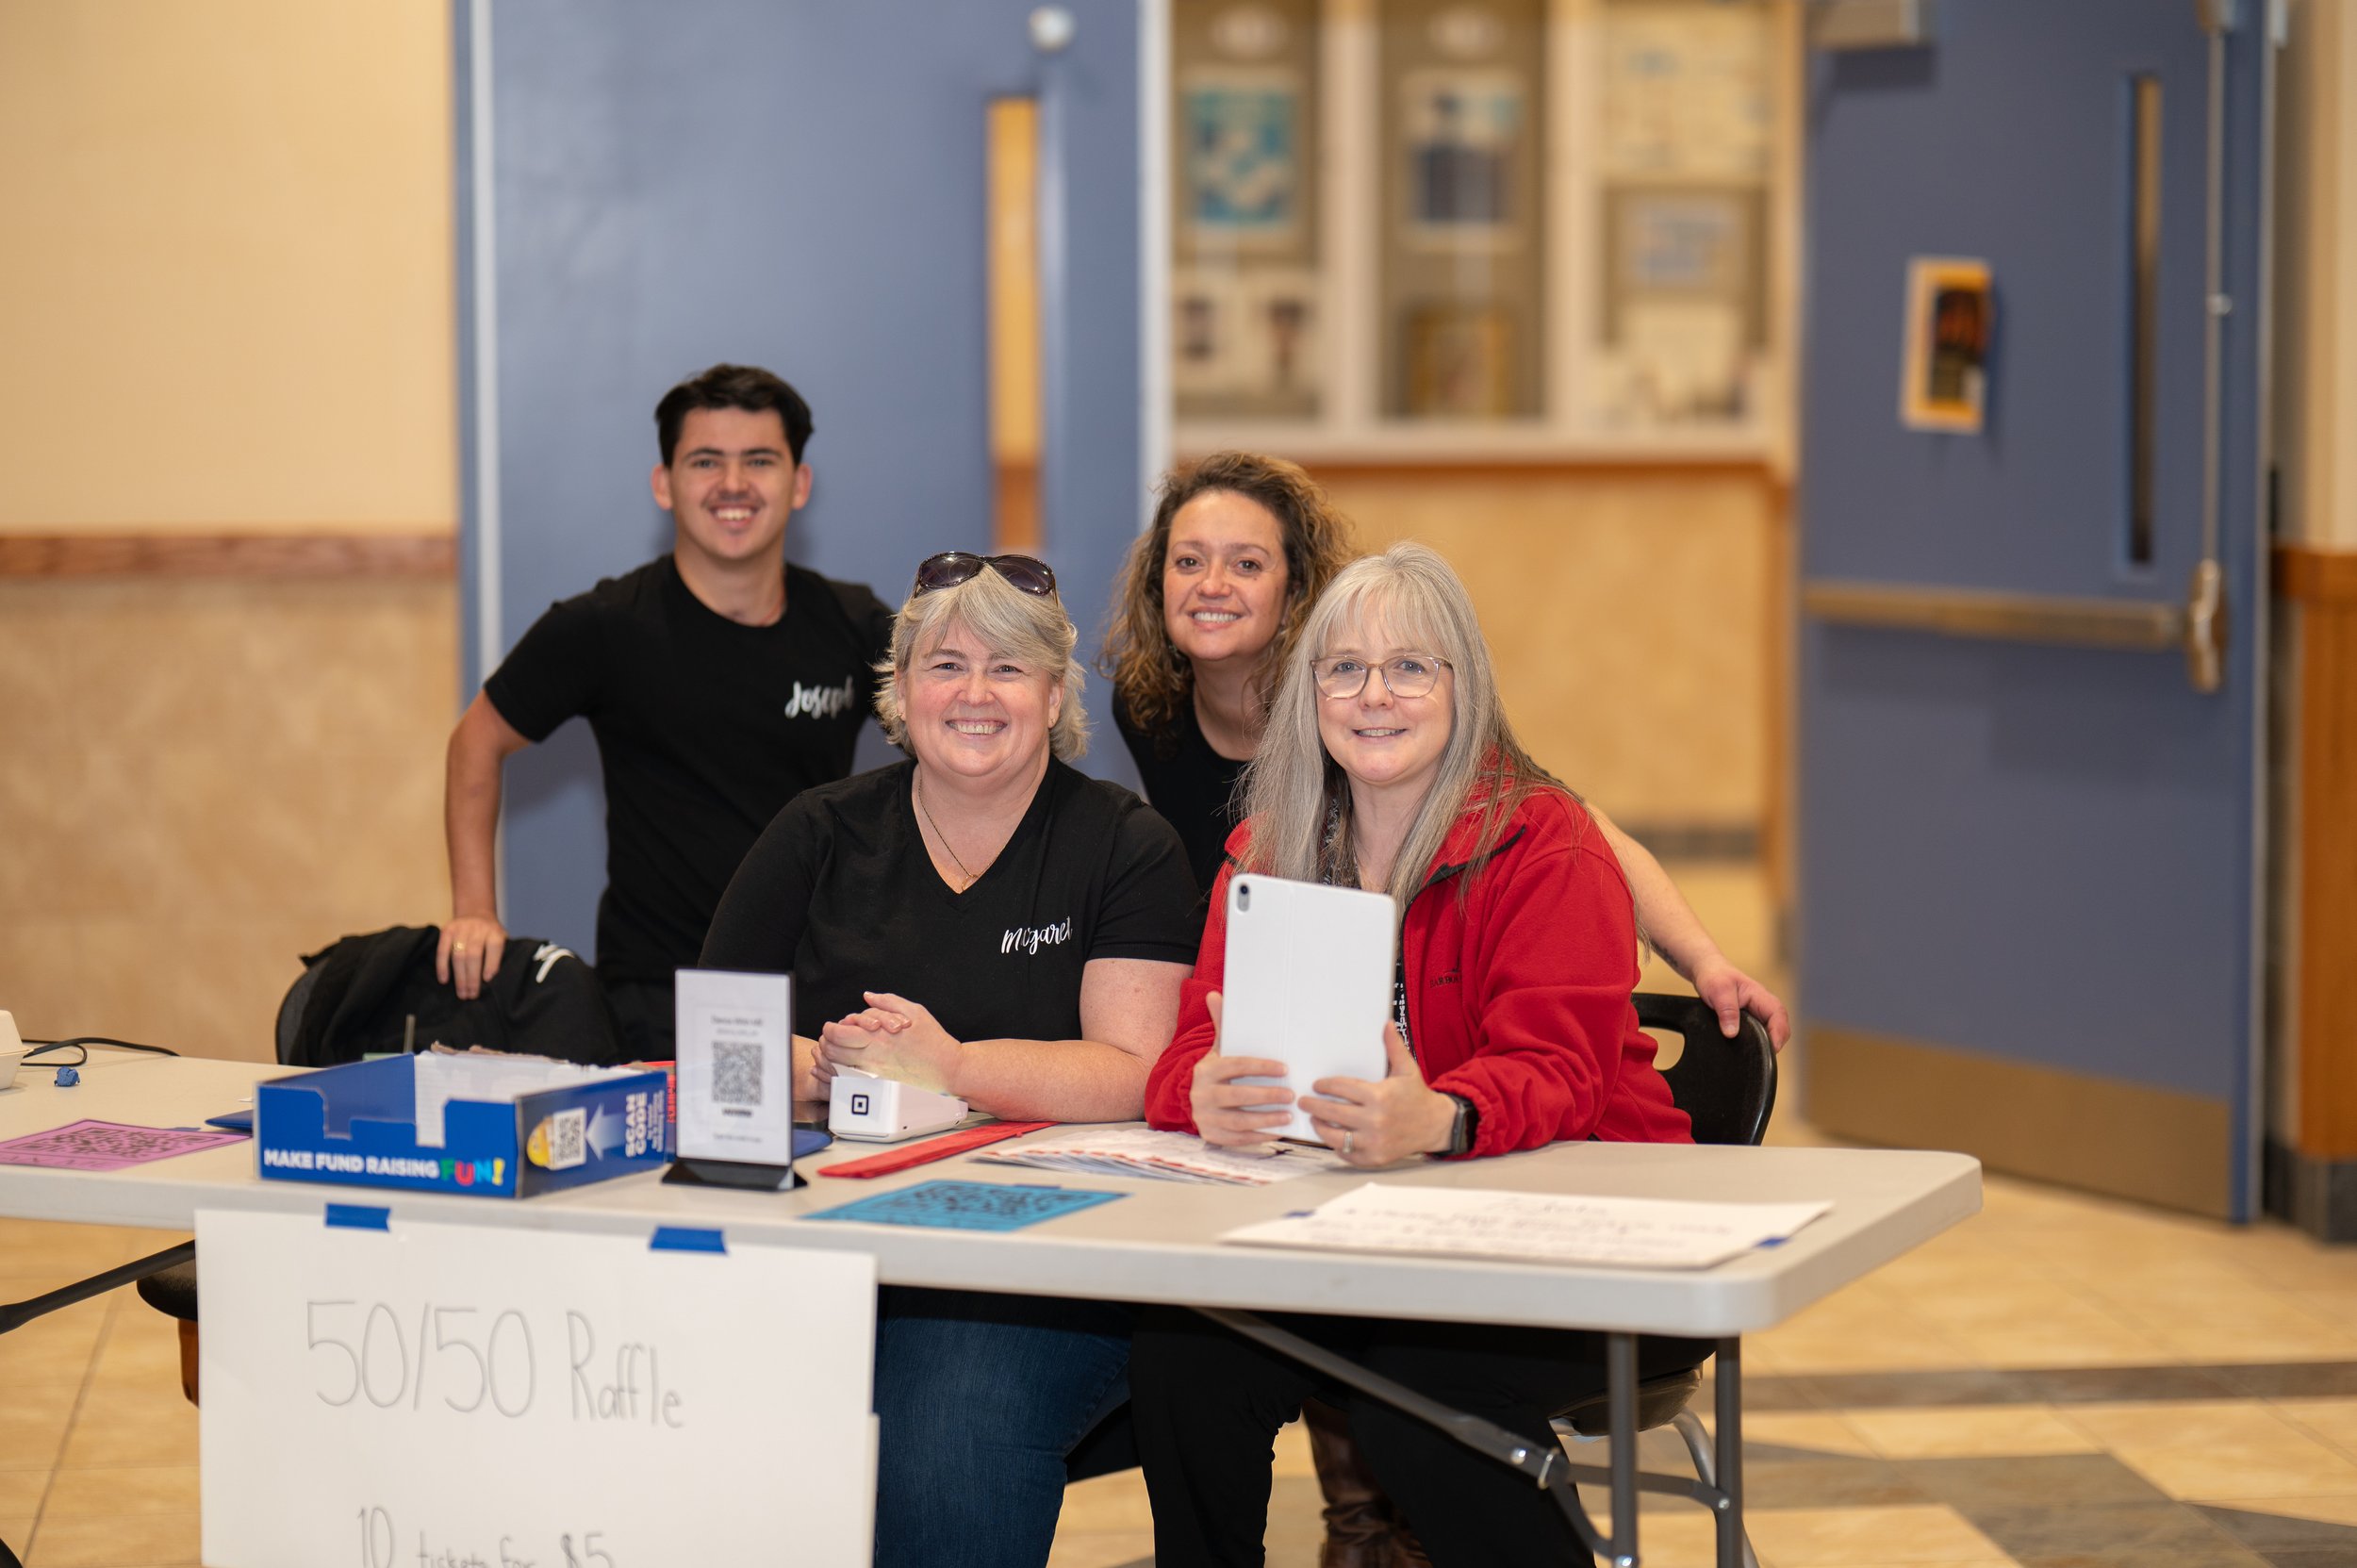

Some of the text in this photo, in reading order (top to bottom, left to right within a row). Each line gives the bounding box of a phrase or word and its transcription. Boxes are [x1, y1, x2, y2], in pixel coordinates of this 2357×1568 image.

[625, 1094, 635, 1158] SCAN
[635, 1092, 647, 1155] CODE
[263, 1147, 505, 1187] MAKE FUND RAISING FUN!
[305, 1299, 684, 1429] 50/50 Raffle
[356, 1506, 395, 1568] 10
[560, 1530, 616, 1568] $5
